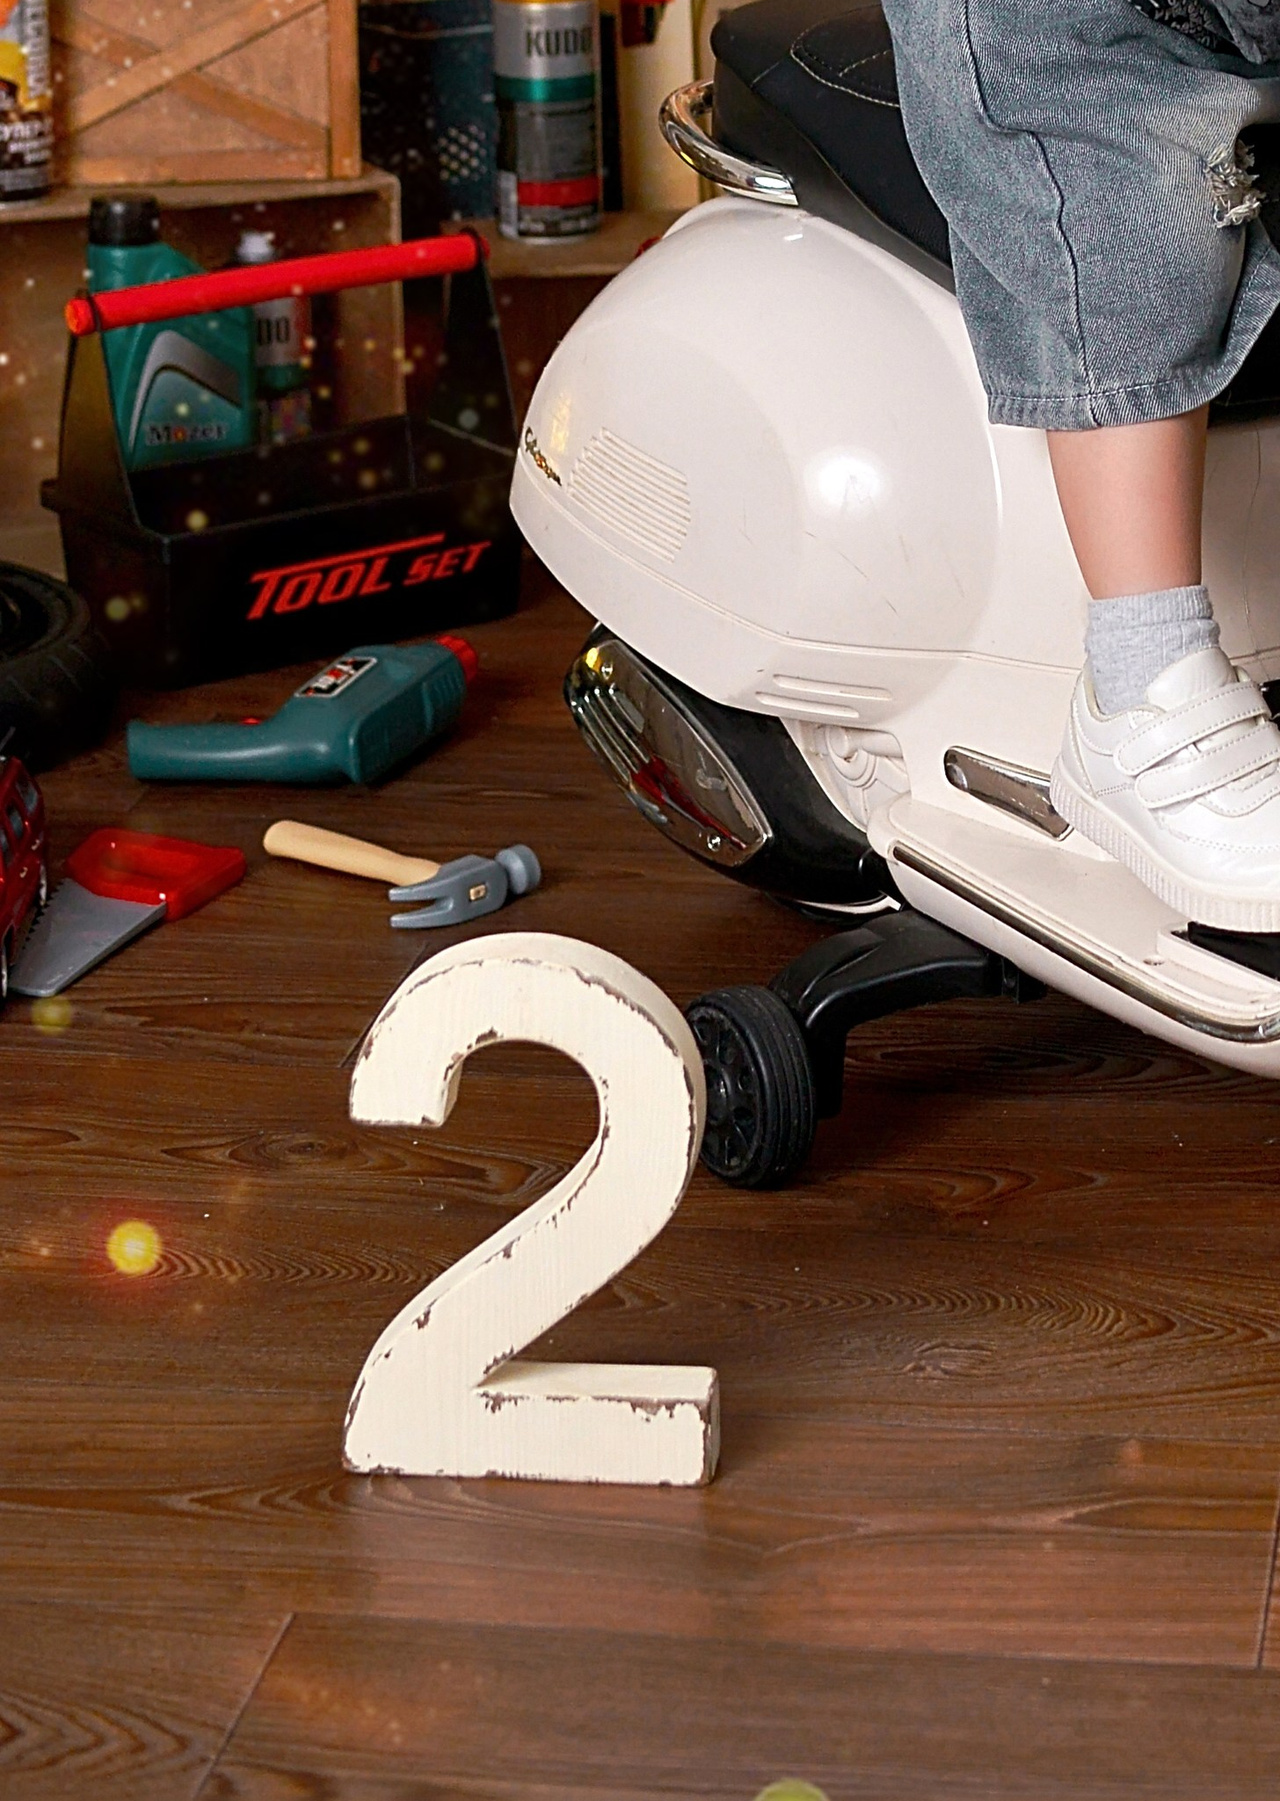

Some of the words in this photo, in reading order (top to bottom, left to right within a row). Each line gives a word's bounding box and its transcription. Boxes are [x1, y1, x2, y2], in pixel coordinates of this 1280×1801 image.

[247, 533, 445, 620] TOOL
[402, 541, 492, 587] SET
[343, 930, 720, 1488] 2
